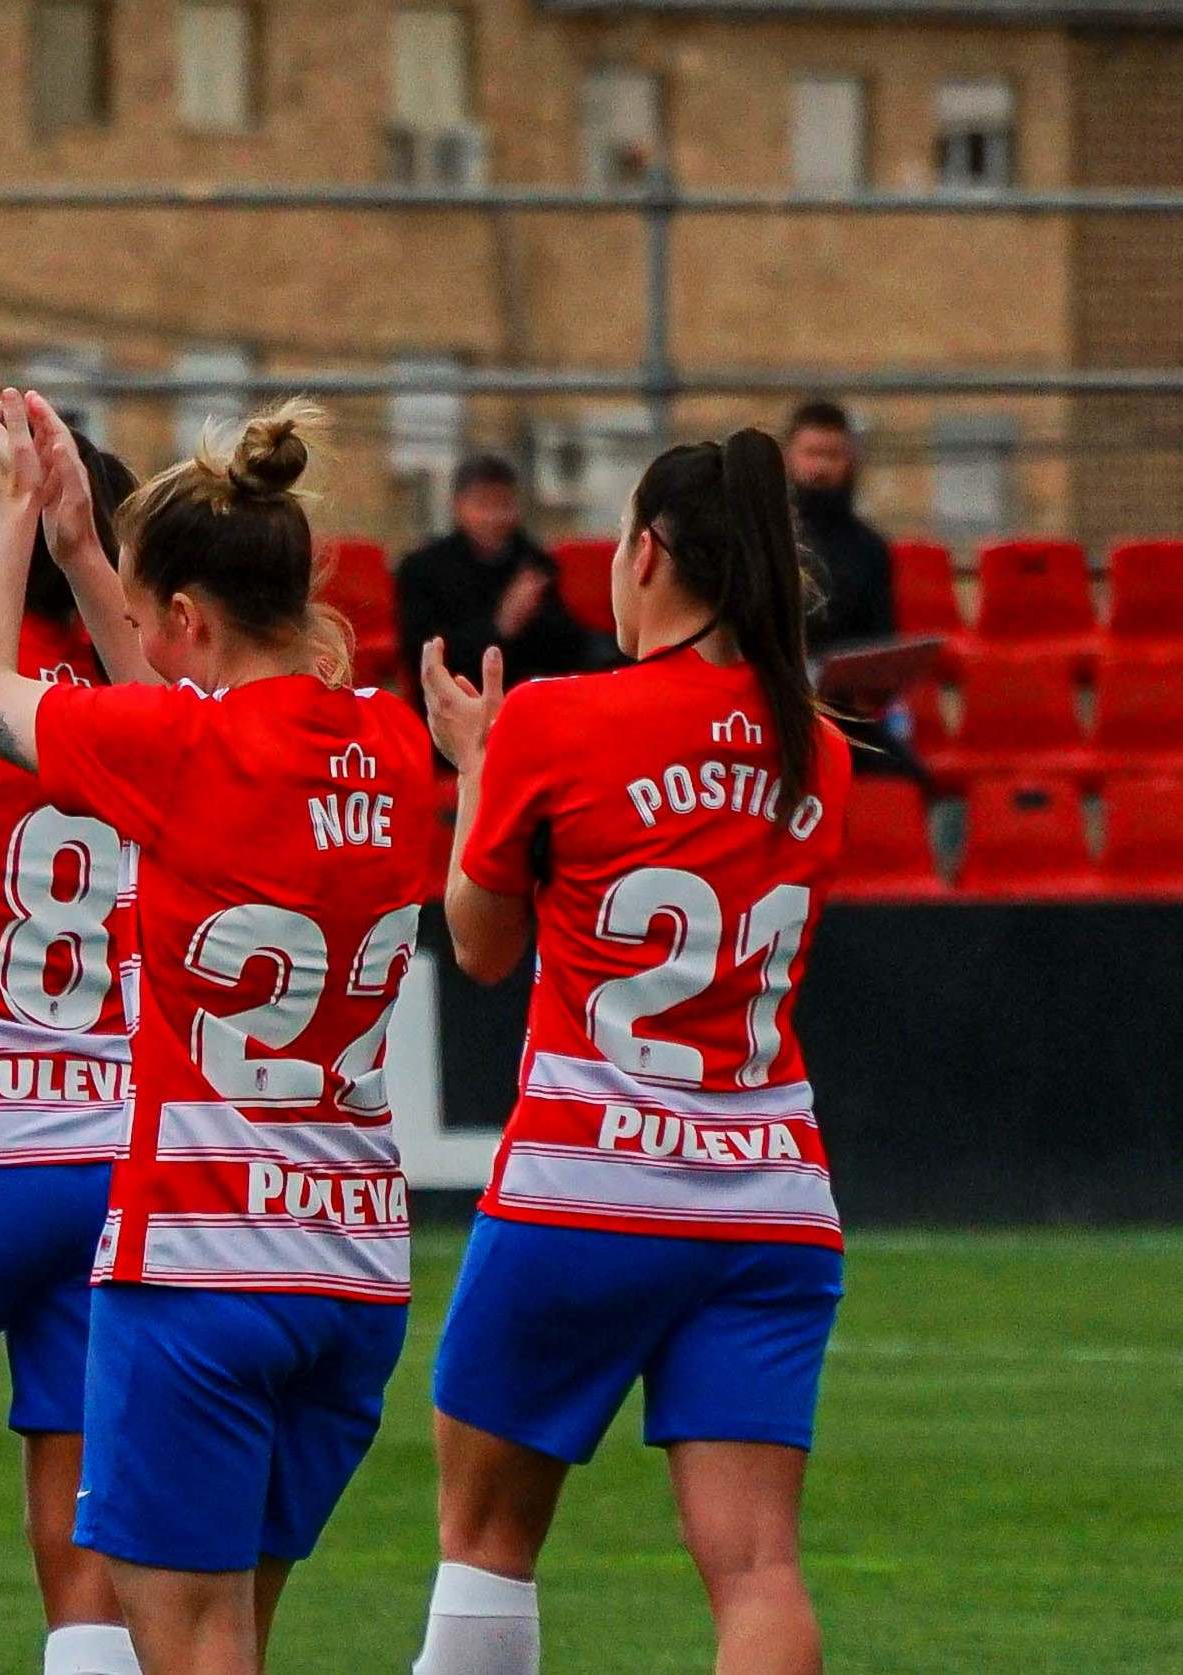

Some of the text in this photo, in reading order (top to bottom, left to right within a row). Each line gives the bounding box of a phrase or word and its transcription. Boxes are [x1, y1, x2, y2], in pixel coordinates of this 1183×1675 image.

[308, 790, 394, 850] NOE
[585, 866, 810, 1089] 21
[184, 903, 421, 1117] 22
[598, 1105, 801, 1162] PULEVA
[248, 1162, 409, 1224] PULEVA
